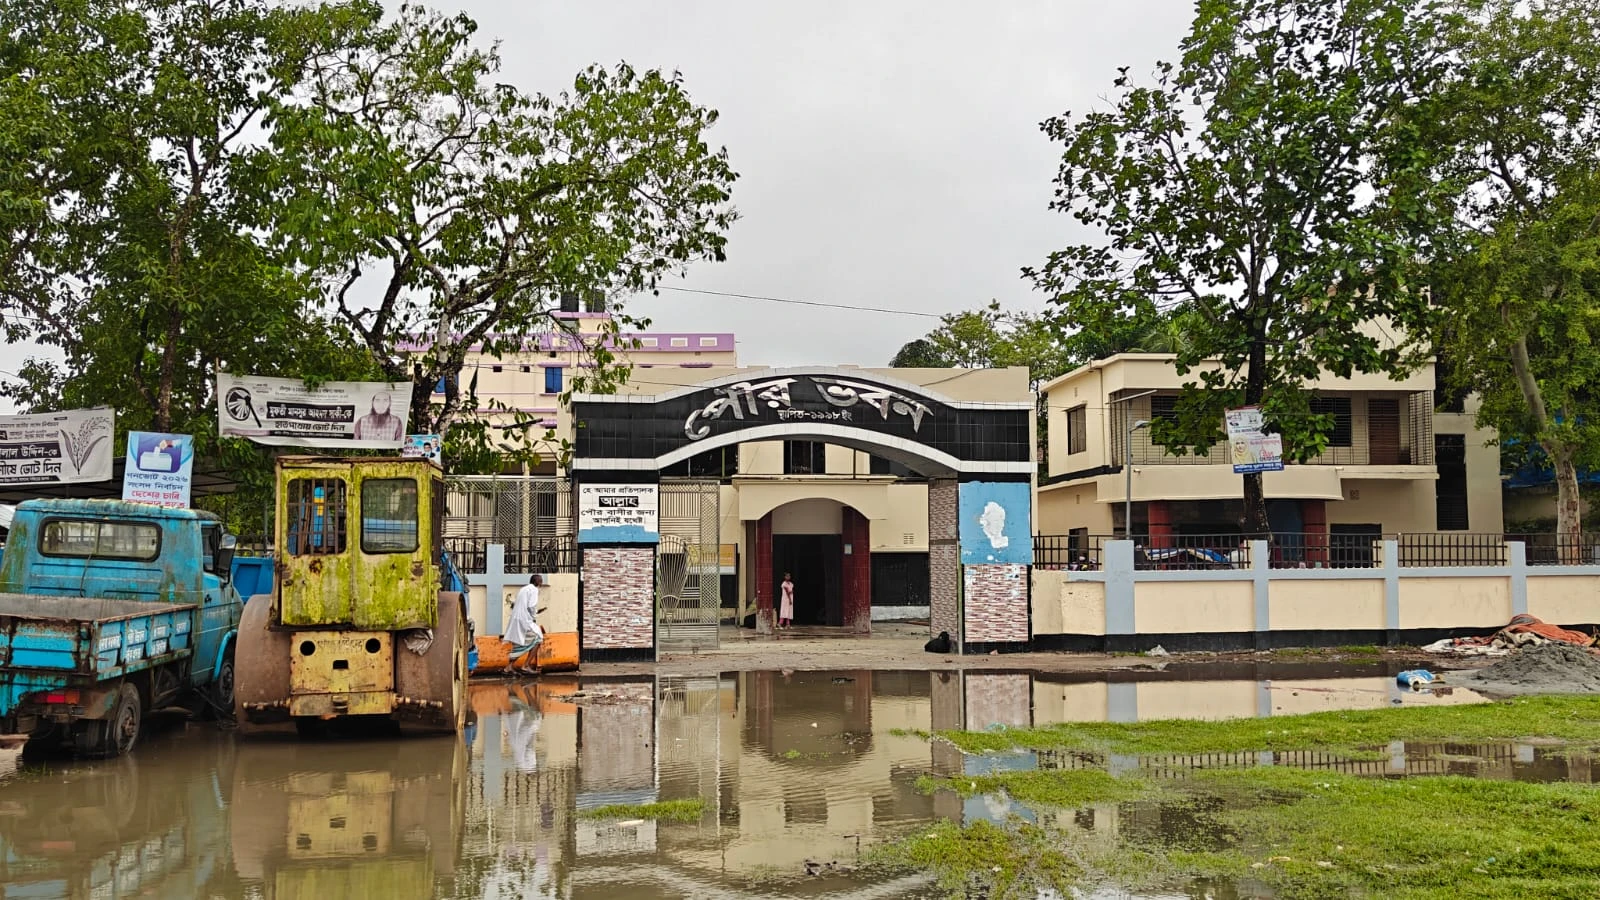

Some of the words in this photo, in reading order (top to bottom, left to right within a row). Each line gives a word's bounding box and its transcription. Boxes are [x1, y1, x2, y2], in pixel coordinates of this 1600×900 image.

[684, 378, 798, 440] পৌর
[808, 377, 934, 433] ভবন
[312, 423, 330, 431] ভোট
[331, 422, 345, 432] দিন
[20, 460, 41, 475] ভোট
[43, 458, 62, 474] দিন
[618, 485, 655, 494] প্রতিপালক
[581, 507, 603, 516] পৌর
[606, 507, 632, 516] বাসীর
[592, 515, 622, 524] আপনিই
